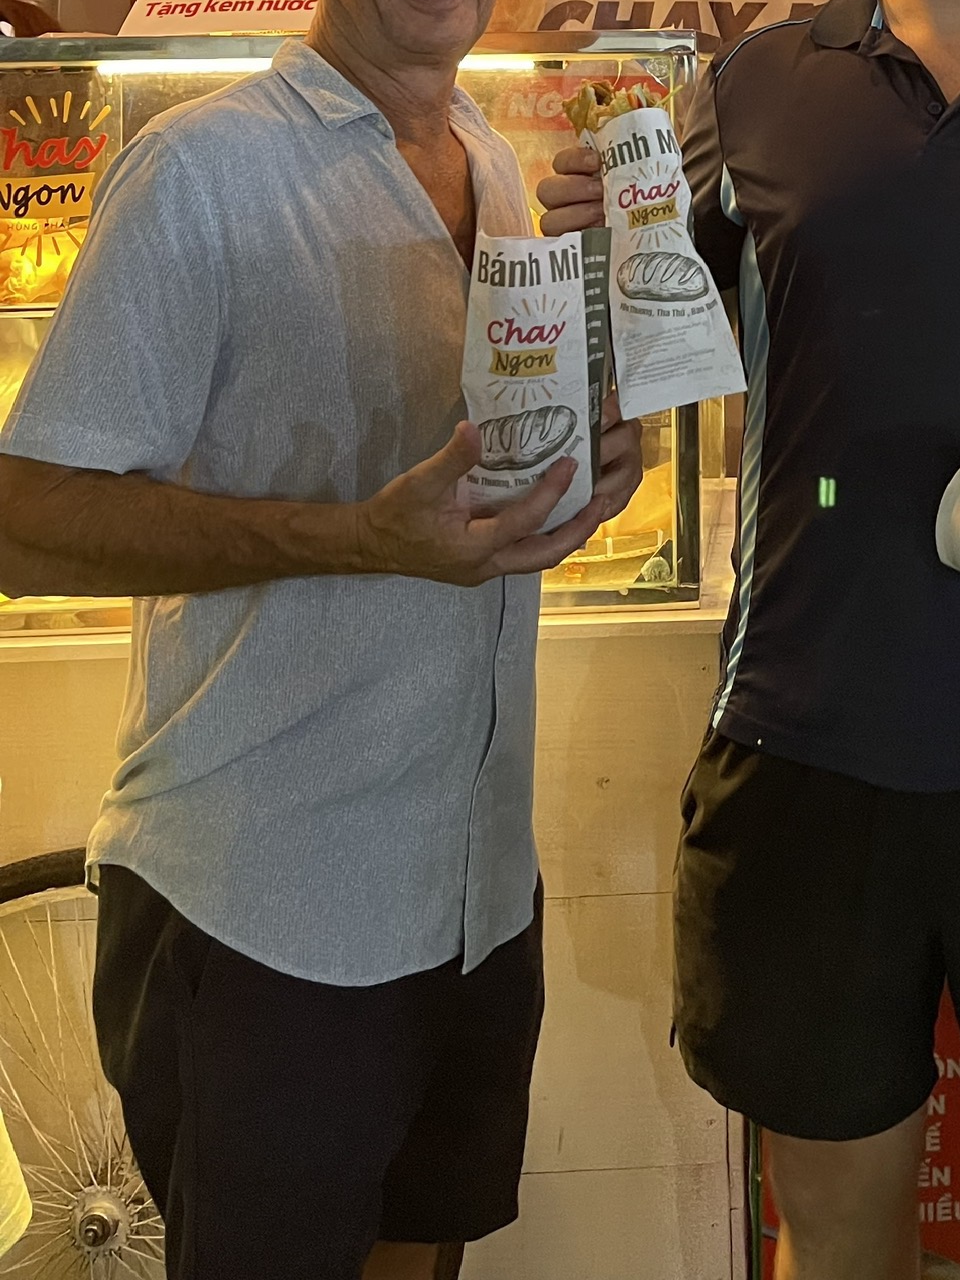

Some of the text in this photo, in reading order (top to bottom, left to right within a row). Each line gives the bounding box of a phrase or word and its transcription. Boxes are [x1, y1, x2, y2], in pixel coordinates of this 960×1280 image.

[145, 1, 202, 19] Tặng
[618, 180, 680, 209] Chay
[631, 203, 675, 226] Ngon
[477, 244, 580, 288] Bánh Mì
[487, 318, 566, 345] Chay
[495, 351, 554, 377] Ngon
